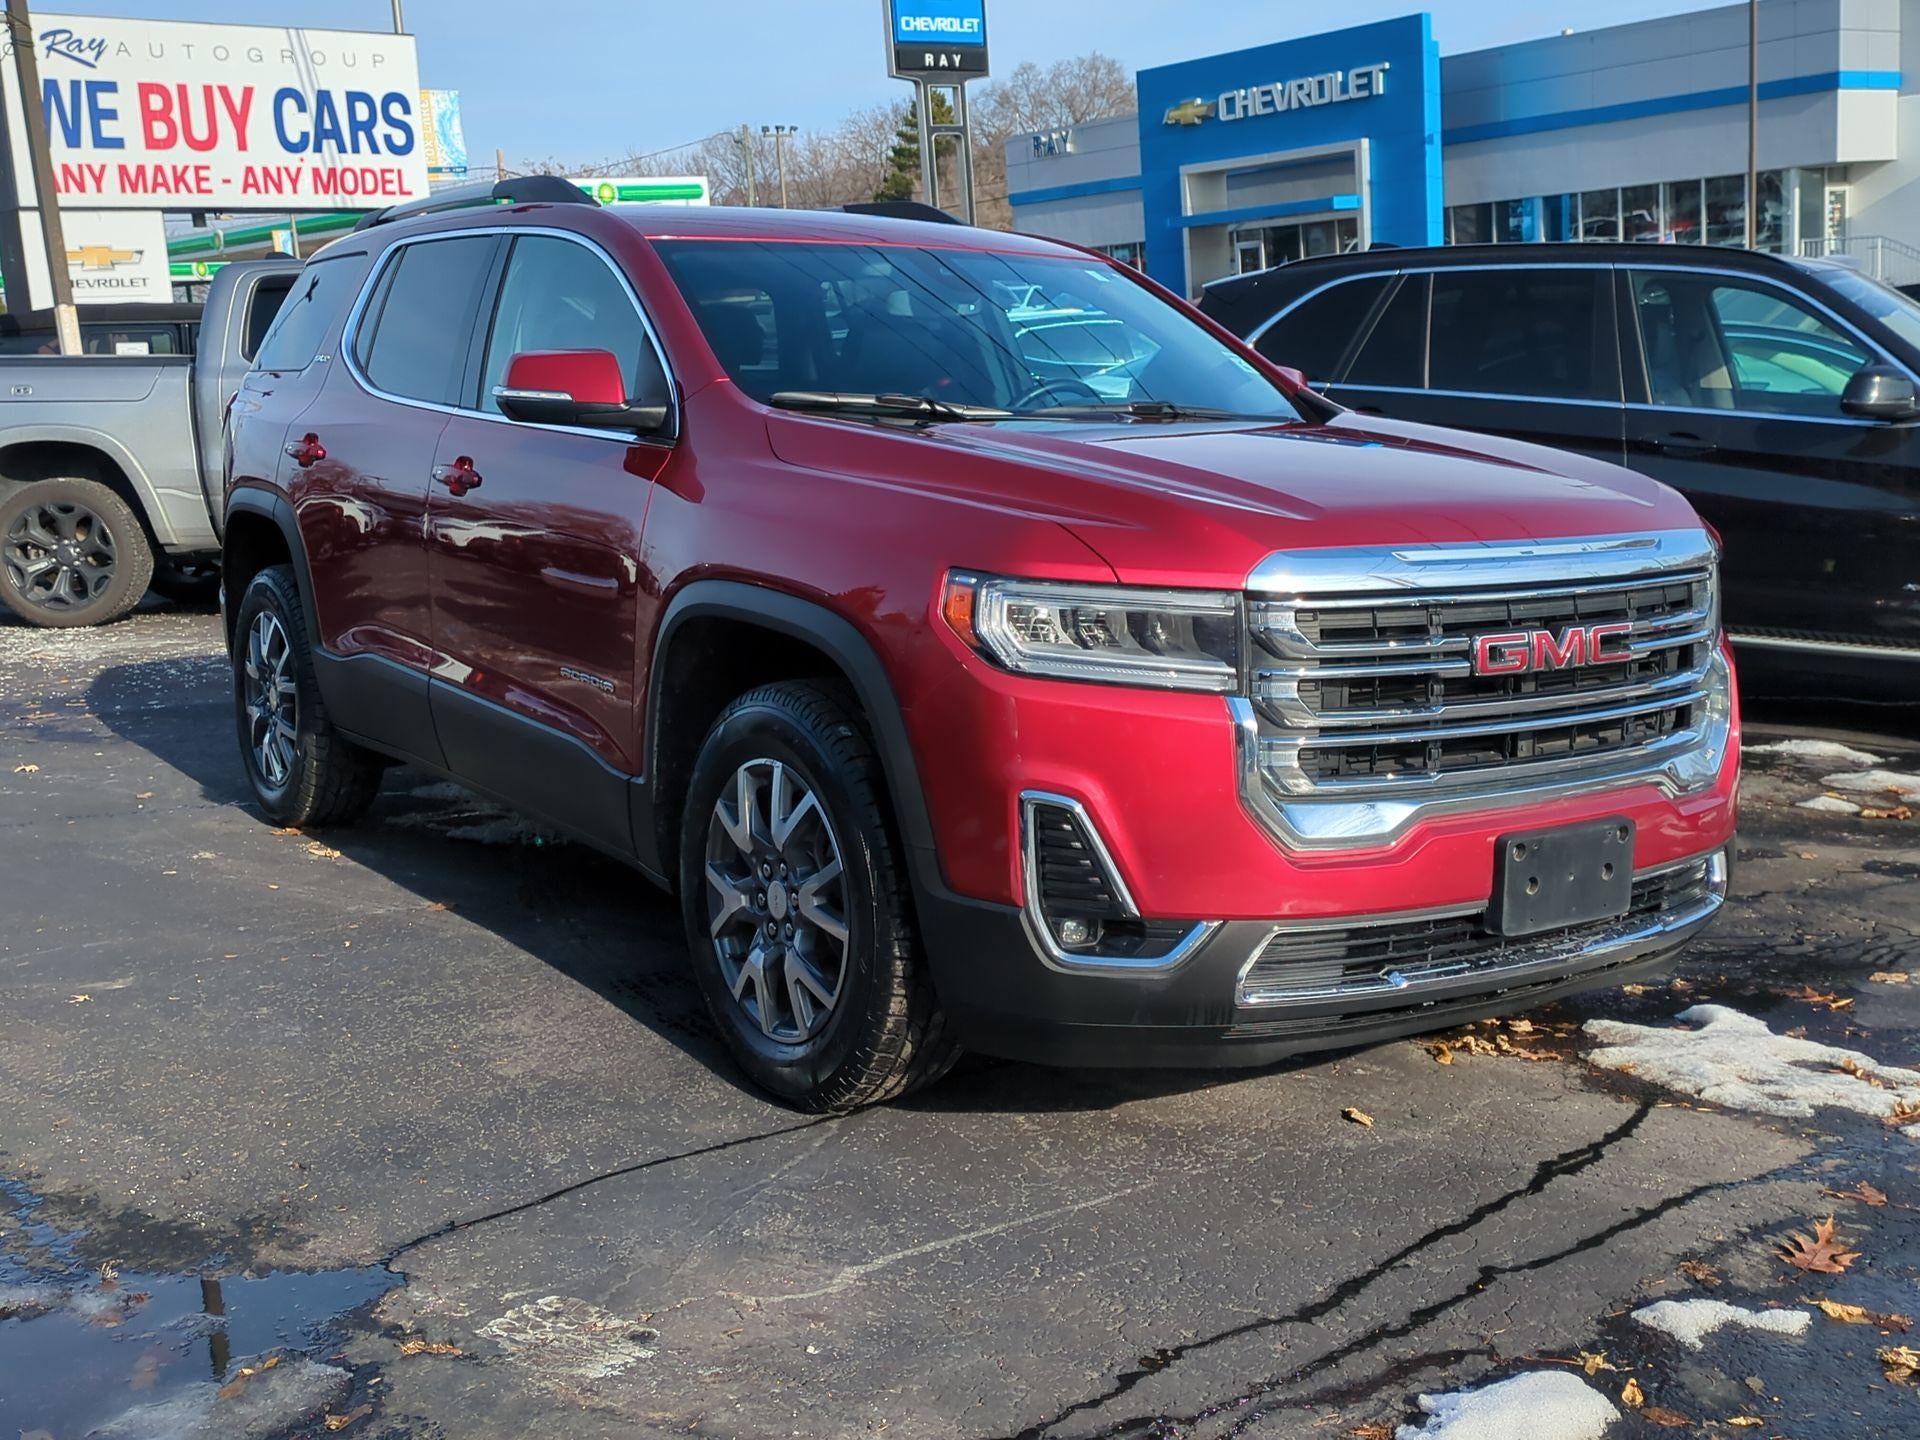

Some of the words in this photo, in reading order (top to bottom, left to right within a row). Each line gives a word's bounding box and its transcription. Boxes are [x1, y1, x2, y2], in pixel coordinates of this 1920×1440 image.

[900, 16, 980, 32] CHEVROLET
[40, 29, 108, 68] Ray
[924, 53, 961, 67] RAY
[1218, 62, 1391, 121] CHEVROLET
[137, 82, 254, 152] BUY
[273, 87, 415, 156] CARS
[1032, 129, 1073, 158] RAY
[118, 164, 213, 194] MAKE
[242, 165, 302, 194] ANY
[312, 166, 412, 195] MODEL
[71, 277, 149, 289] EVROLET
[1475, 622, 1633, 676] GMC
